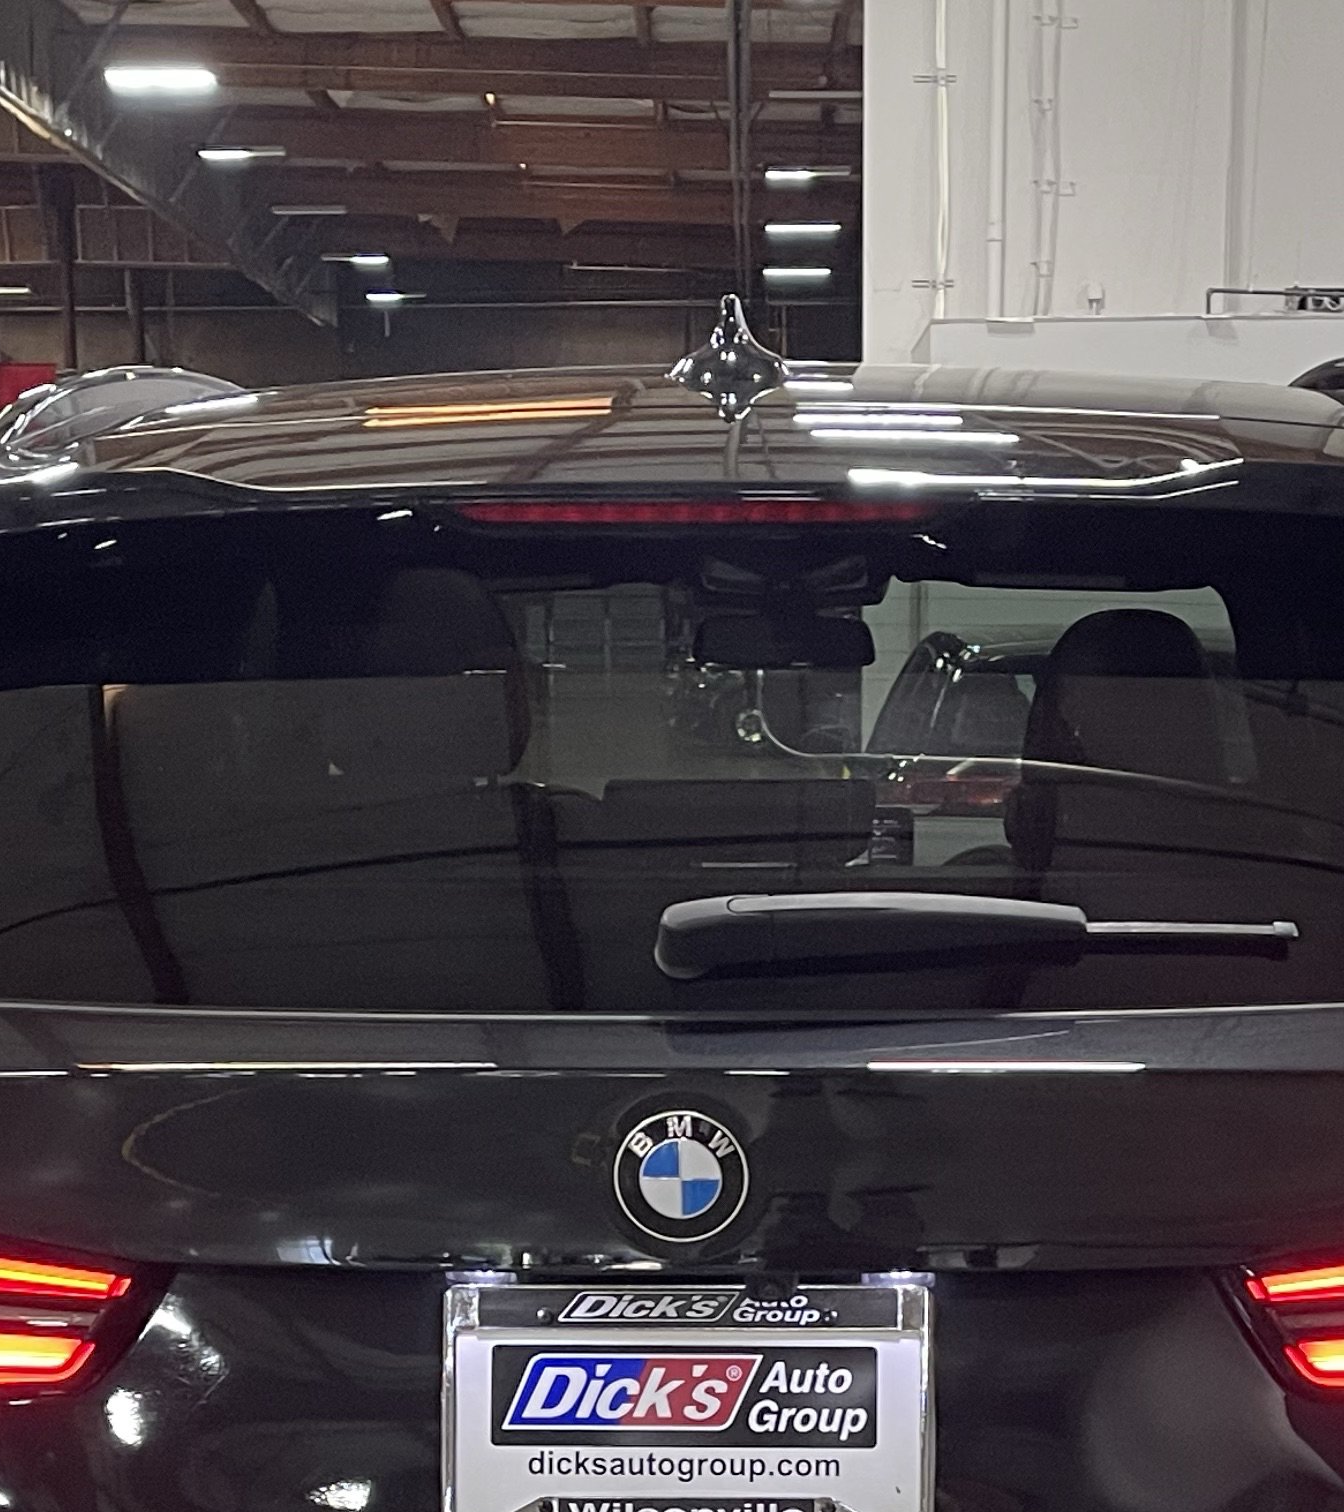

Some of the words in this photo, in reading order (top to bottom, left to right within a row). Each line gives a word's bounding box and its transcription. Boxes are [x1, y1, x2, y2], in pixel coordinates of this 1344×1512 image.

[628, 1115, 735, 1158] BMW
[570, 1295, 719, 1318] Dick's
[733, 1307, 820, 1326] Group
[759, 1362, 853, 1394] Auto
[748, 1401, 868, 1440] Group
[528, 1451, 840, 1482] dicksautogroup.com
